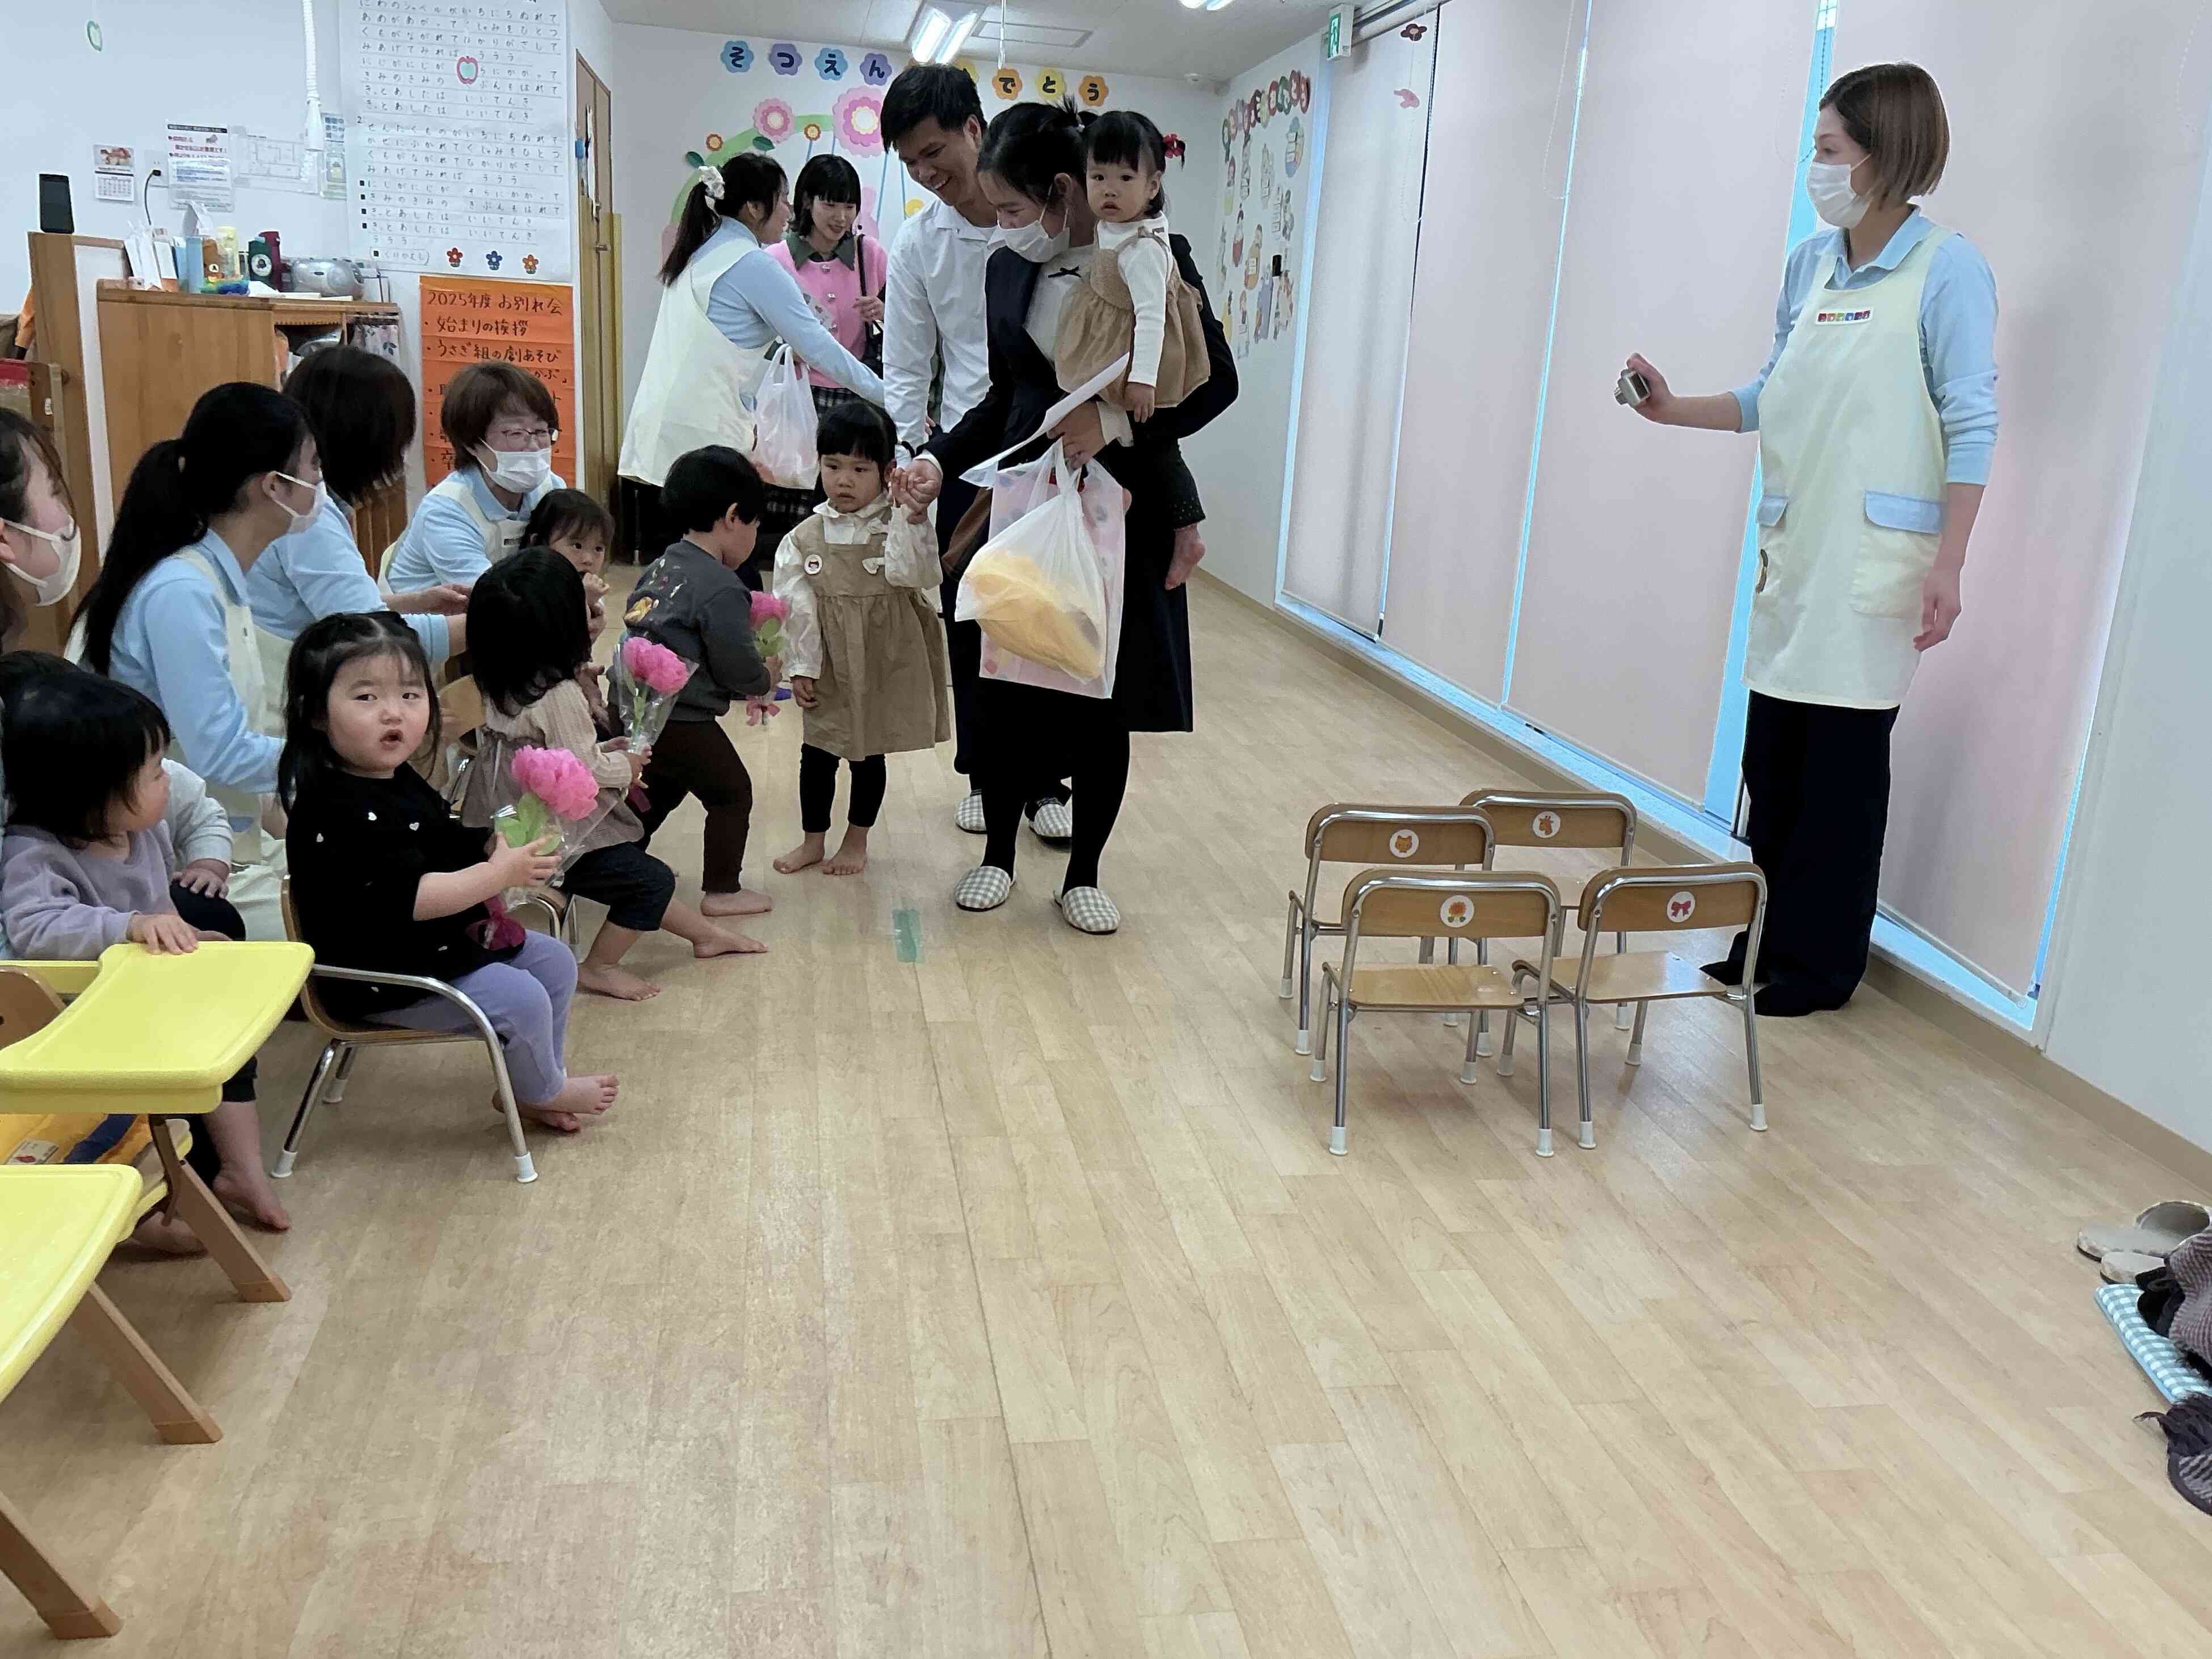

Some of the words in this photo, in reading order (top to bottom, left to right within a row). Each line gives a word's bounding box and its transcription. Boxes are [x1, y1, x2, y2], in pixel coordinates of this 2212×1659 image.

[361, 12, 558, 37] あめがあがってしゃみをひとつ
[480, 65, 557, 81] らにかかって
[729, 46, 885, 79] そつえん
[998, 75, 1100, 101] でとう
[427, 291, 492, 309] 2025年度
[498, 294, 563, 316] お別れ会
